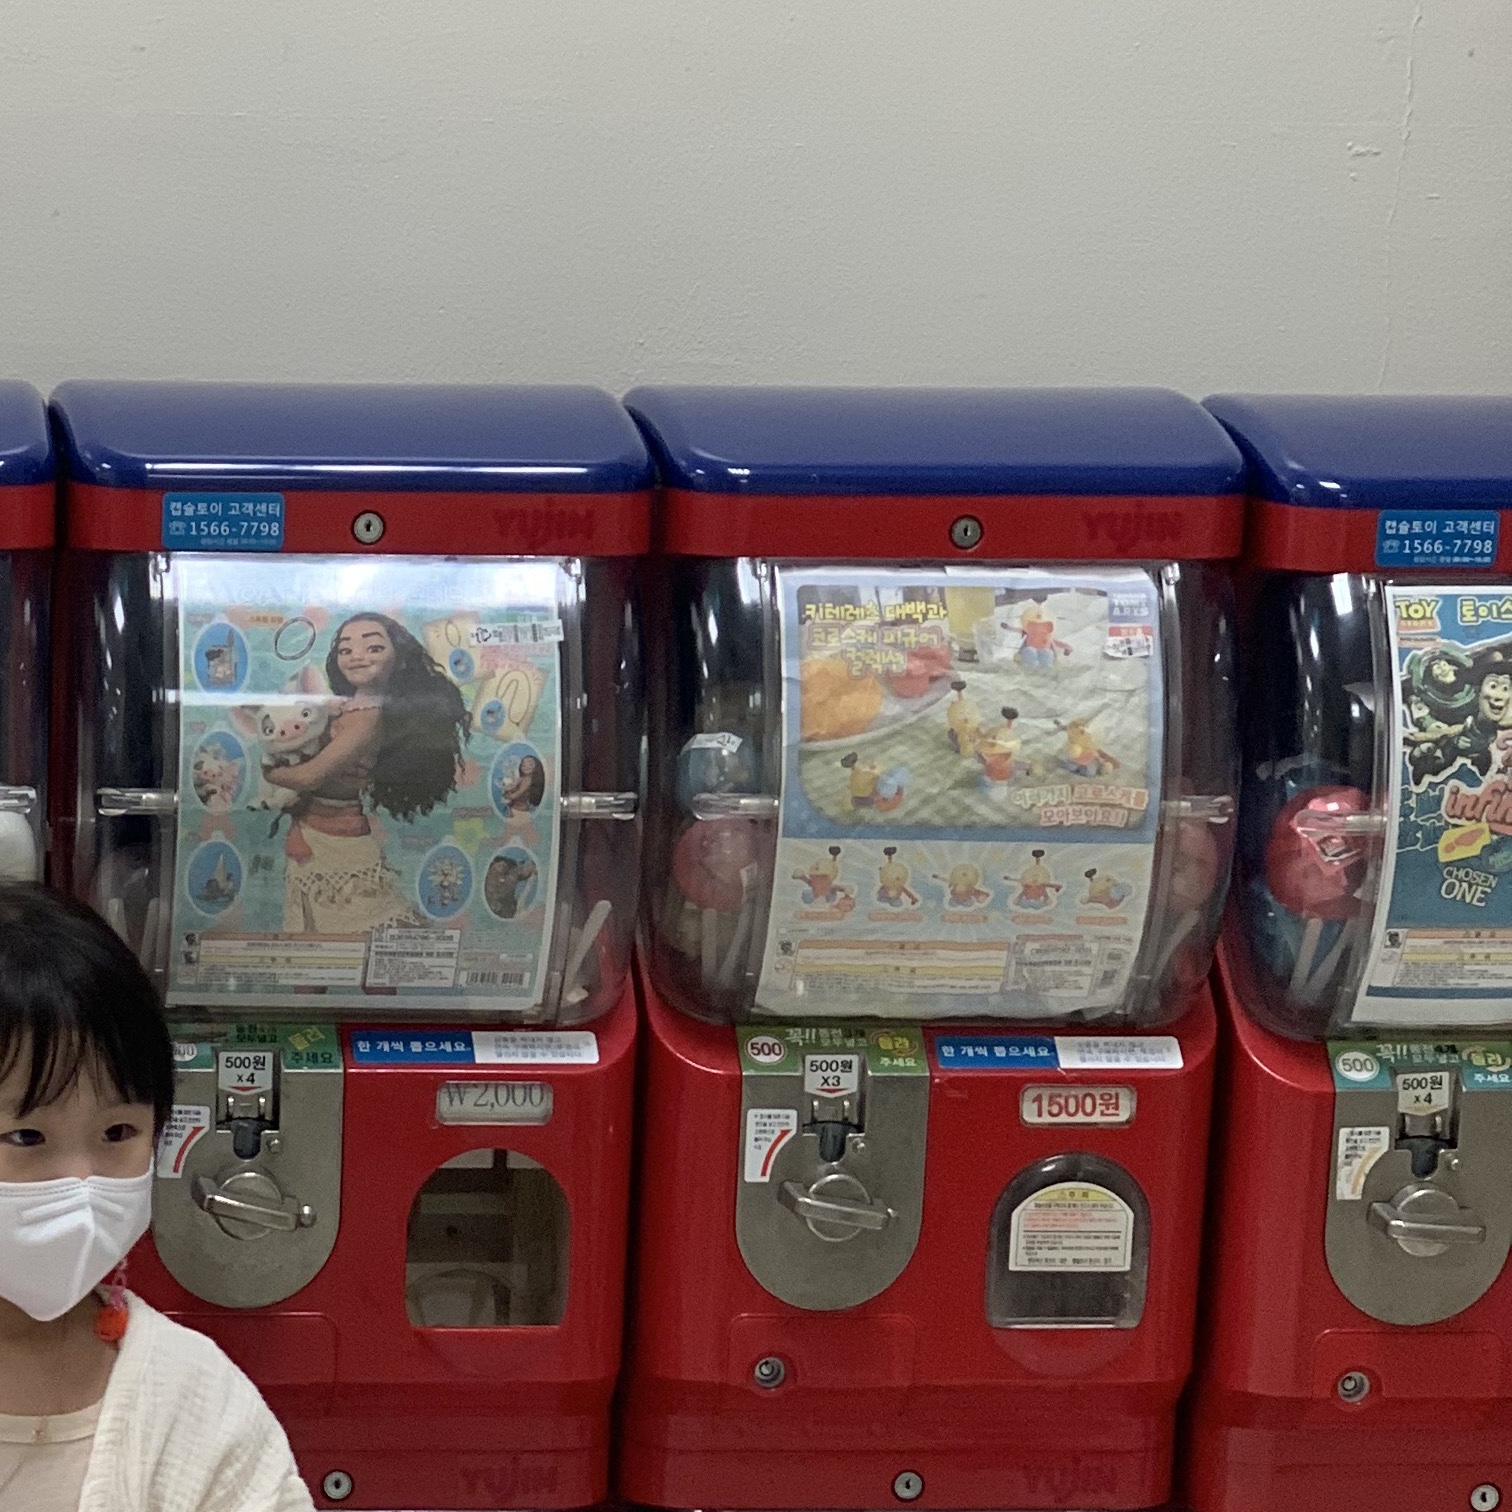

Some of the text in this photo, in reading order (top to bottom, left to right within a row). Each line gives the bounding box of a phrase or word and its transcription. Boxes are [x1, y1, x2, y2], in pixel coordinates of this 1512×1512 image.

[169, 501, 281, 518] 캡슐토이 고객센터
[189, 520, 280, 536] 1566-7798
[1384, 519, 1496, 536] 캡슐토이 고객센터
[1401, 539, 1494, 555] 1566-7798
[885, 600, 949, 624] 대백과
[1394, 599, 1438, 620] TOY
[883, 627, 938, 648] 피규어
[1442, 866, 1499, 889] CHOSEN
[1440, 878, 1492, 908] ONE
[356, 1039, 371, 1053] 한
[376, 1039, 405, 1053] 개씩
[749, 1041, 783, 1057] 500
[941, 1044, 955, 1058] 한
[960, 1044, 989, 1058] 개씩
[225, 1055, 266, 1071] 500원
[809, 1059, 853, 1074] 500원
[1341, 1057, 1375, 1074] 500
[1402, 1074, 1444, 1091] 500원
[1031, 1090, 1121, 1118] 1500원
